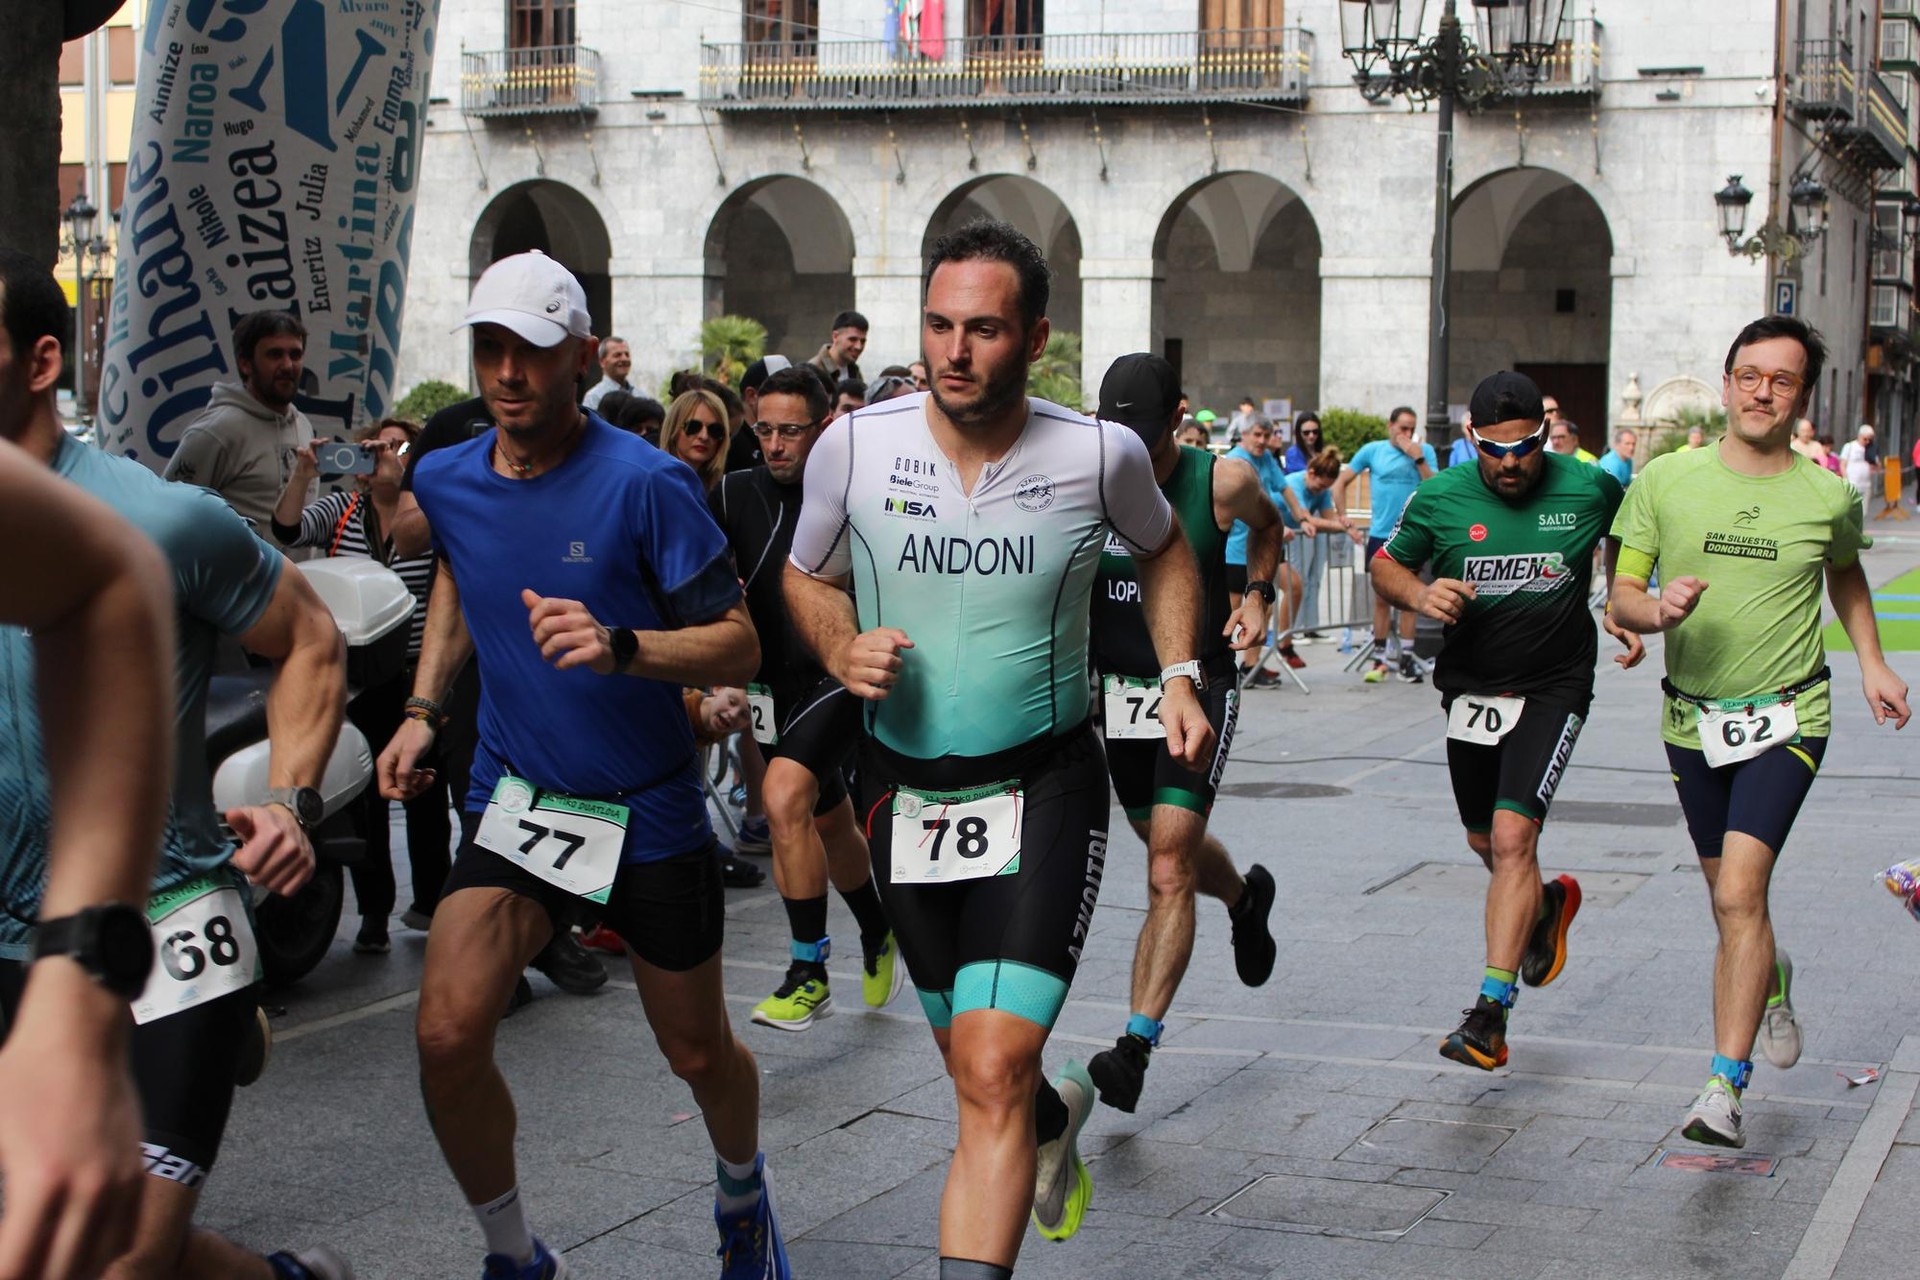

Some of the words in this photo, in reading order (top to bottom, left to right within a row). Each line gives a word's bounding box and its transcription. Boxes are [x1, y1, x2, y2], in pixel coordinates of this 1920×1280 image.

[191, 43, 209, 55] Enzo
[150, 41, 184, 125] Ainhize
[171, 64, 220, 163] Naroa
[373, 66, 405, 135] Emma
[224, 119, 254, 137] Hugo
[344, 96, 376, 143] Mohamed
[296, 163, 328, 221] Julia
[187, 184, 229, 250] Nikole
[303, 236, 331, 314] Eneritz
[328, 142, 382, 385] Martina
[1779, 285, 1791, 311] P
[890, 474, 940, 493] BieleGroup
[895, 457, 936, 477] GOBIK
[1538, 513, 1577, 526] SALTO
[898, 533, 1034, 576] ANDONI
[1706, 531, 1726, 541] SAN
[1728, 534, 1779, 548] SILVESTRE
[1707, 542, 1776, 559] DONOSTIARRA
[1466, 556, 1548, 581] KEMEN
[748, 704, 766, 731] 2
[1126, 697, 1162, 725] 74
[1467, 702, 1503, 733] 70
[1721, 715, 1773, 748] 62
[518, 818, 586, 871] 77
[922, 816, 989, 861] 78
[160, 915, 240, 982] 68
